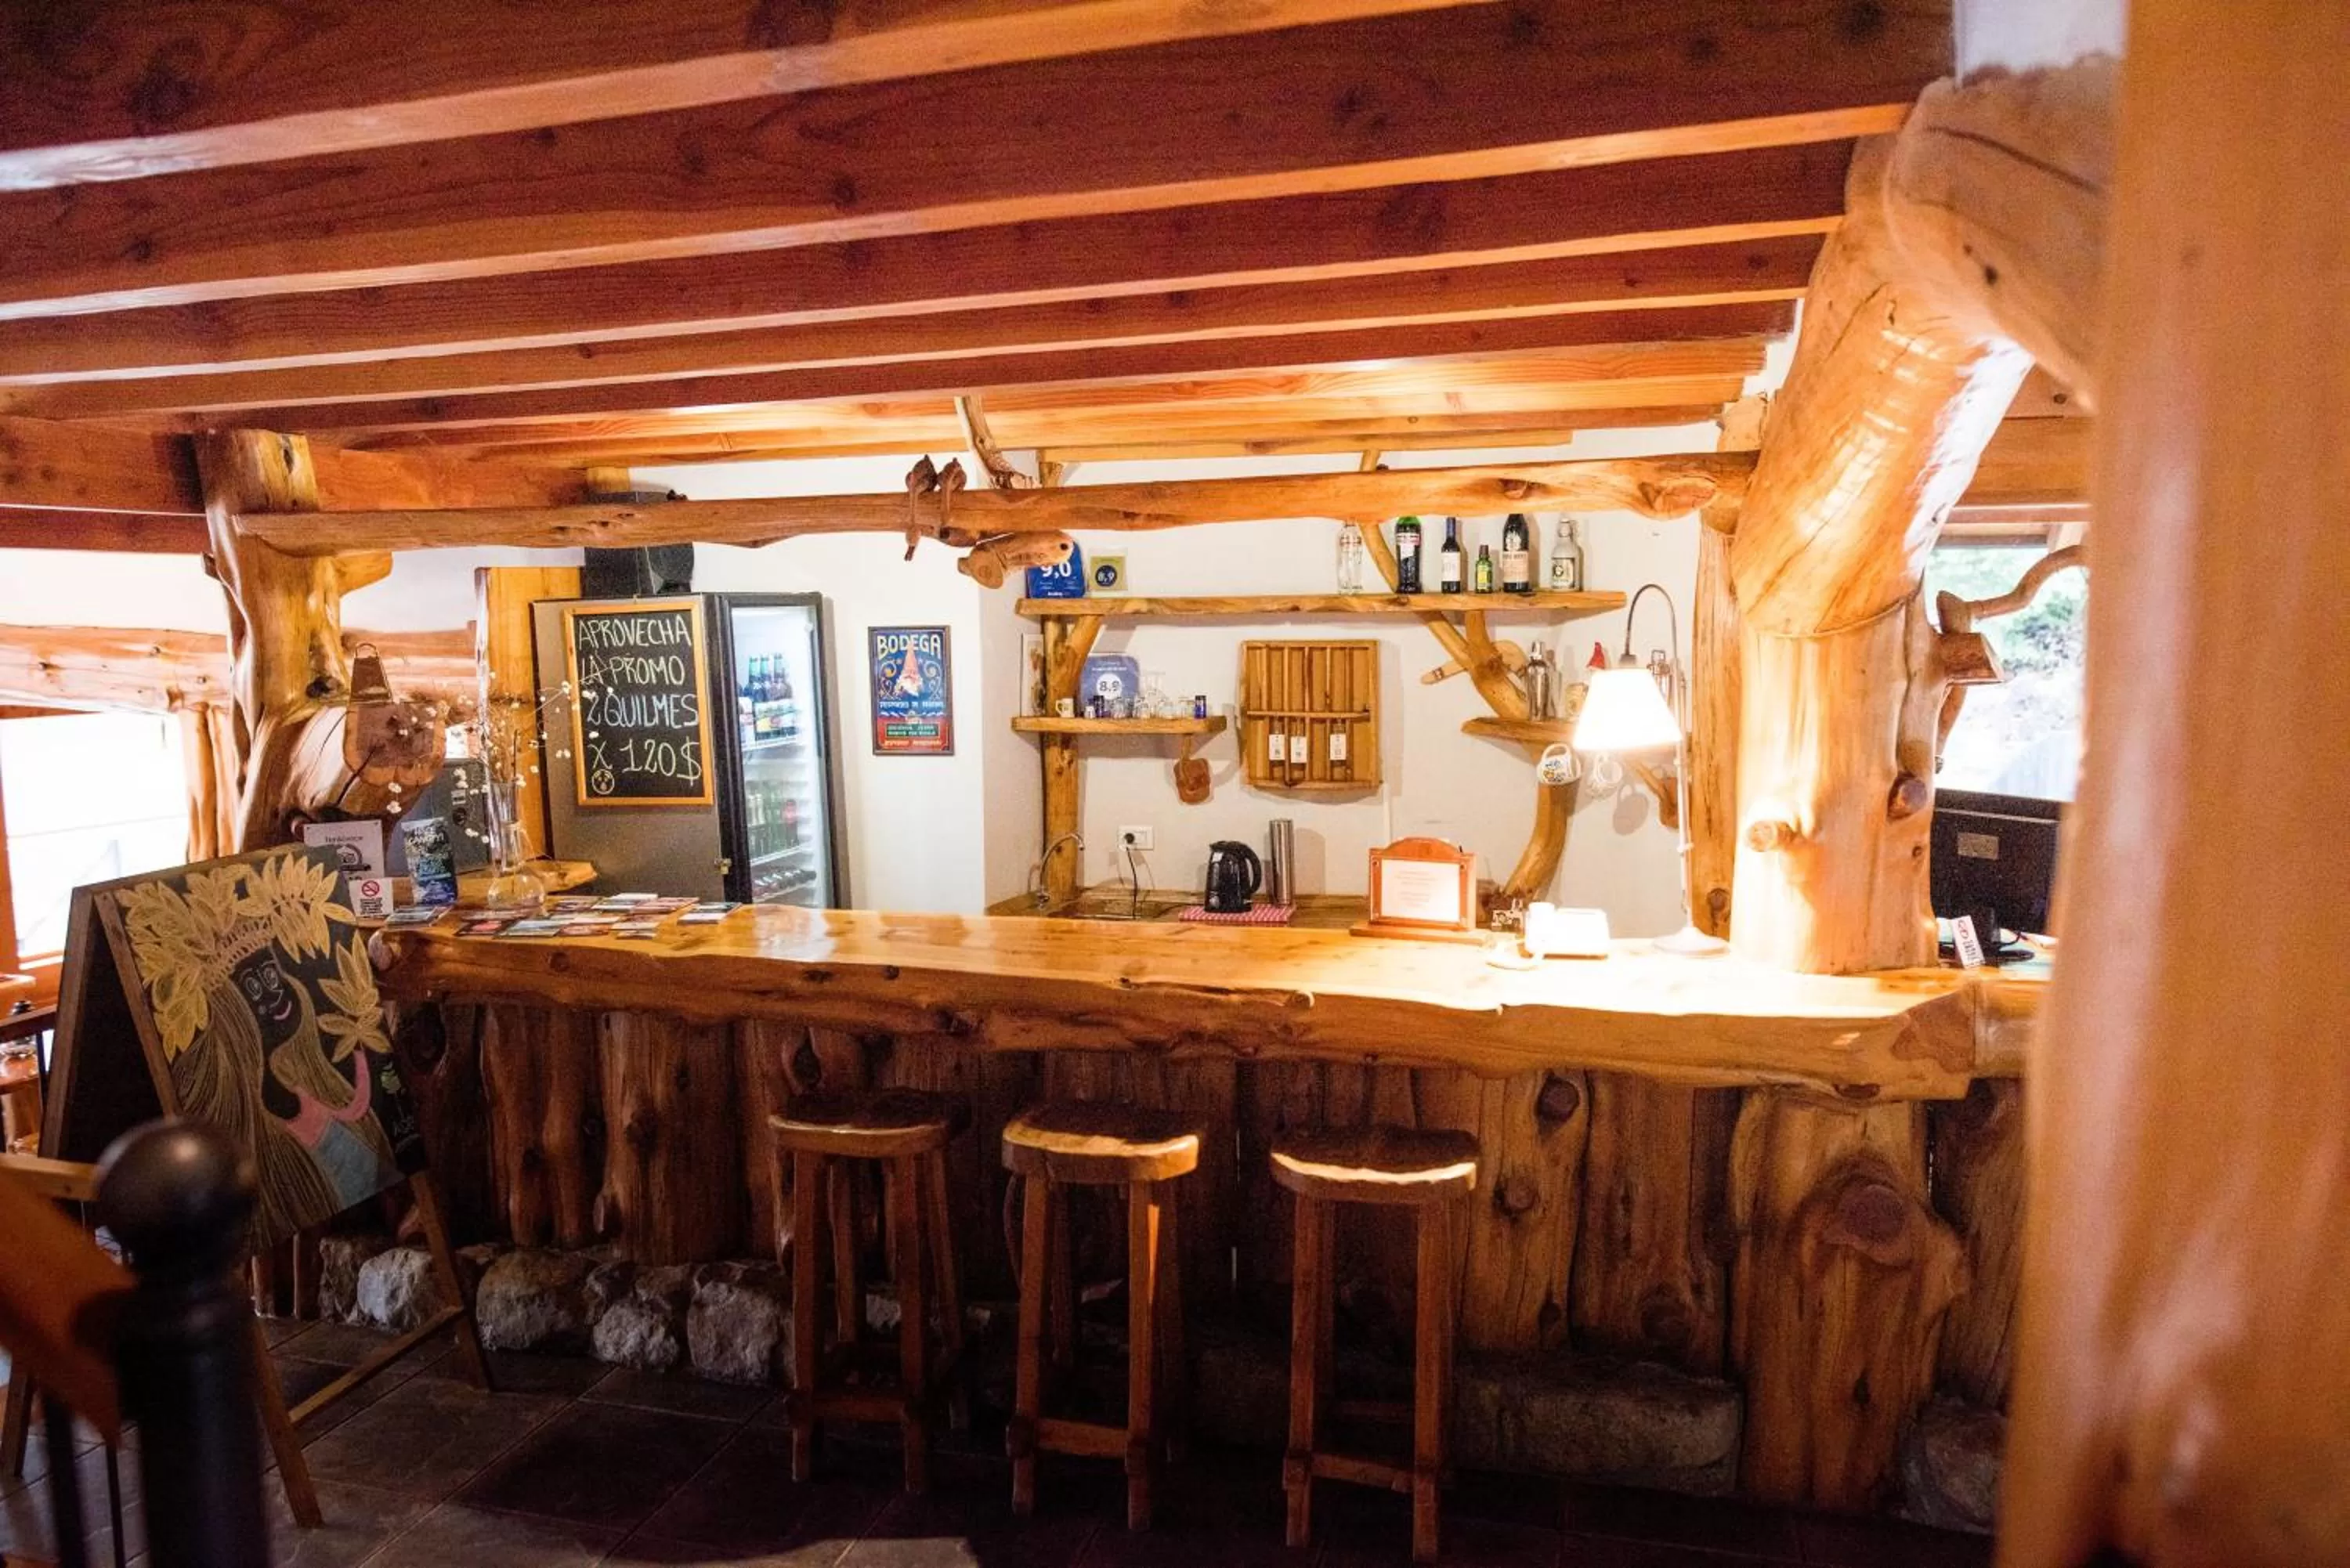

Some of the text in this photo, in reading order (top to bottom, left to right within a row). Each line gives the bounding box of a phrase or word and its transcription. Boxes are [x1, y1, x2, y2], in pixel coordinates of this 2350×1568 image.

[578, 615, 692, 650] APROVECHA
[877, 633, 942, 660] BODEGA
[580, 655, 685, 685] LA PROMO
[588, 692, 700, 728] 2 QUILMES
